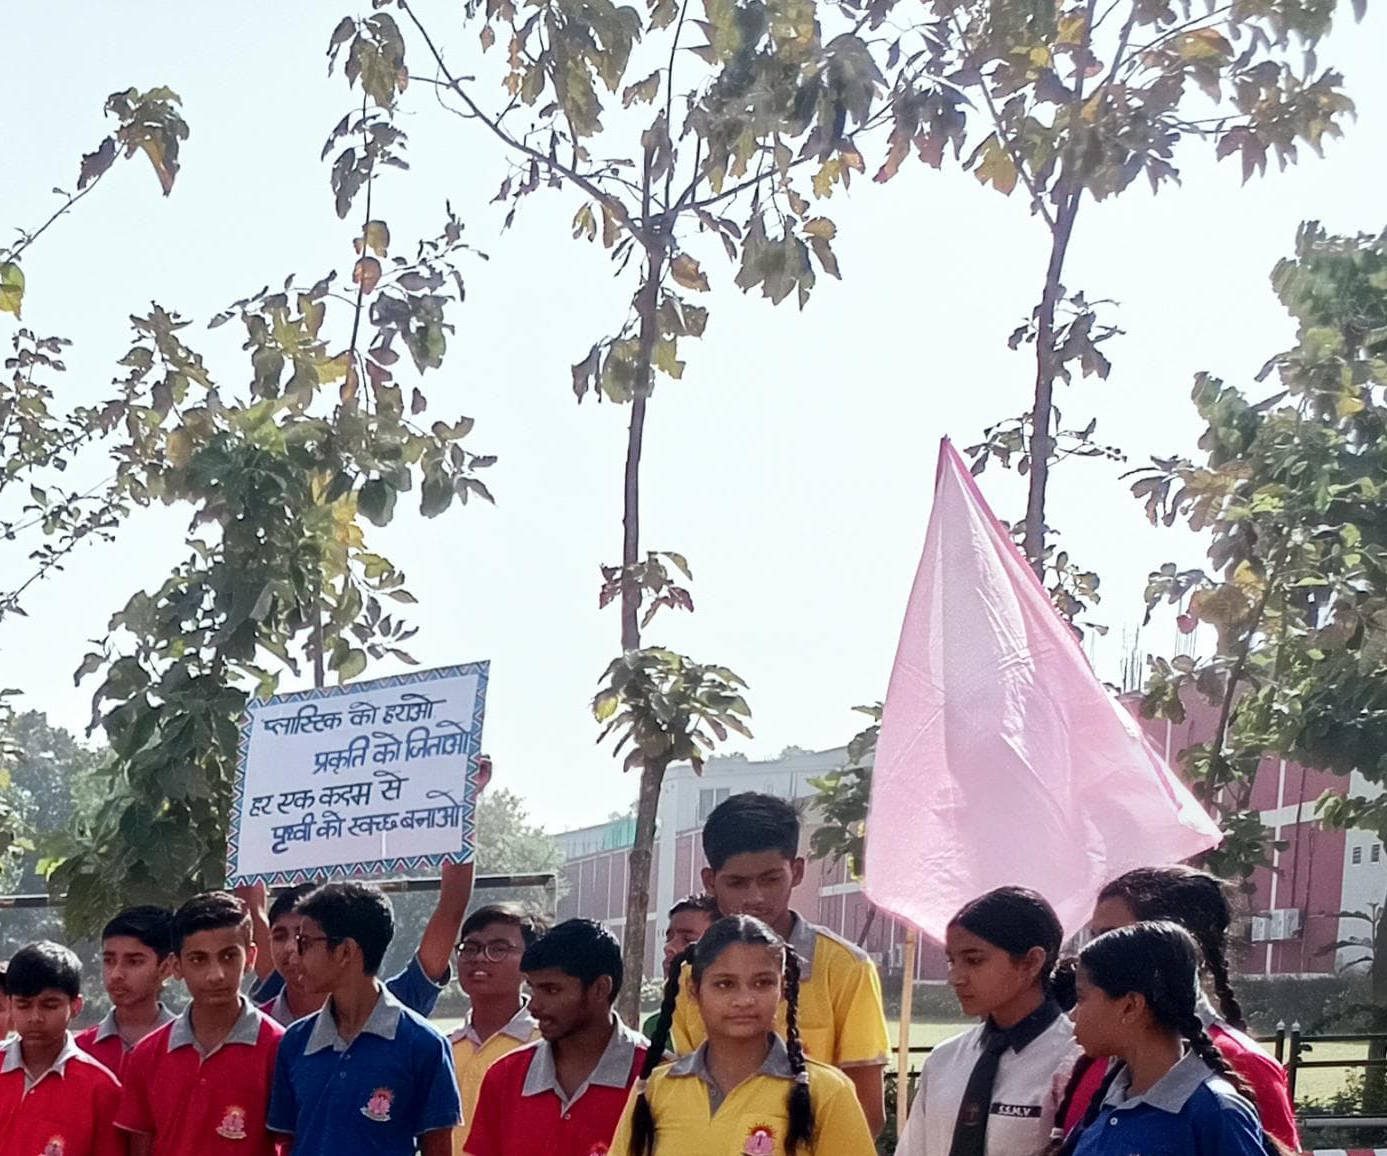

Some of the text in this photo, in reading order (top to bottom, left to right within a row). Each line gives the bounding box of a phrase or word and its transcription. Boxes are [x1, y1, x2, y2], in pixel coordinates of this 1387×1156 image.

[263, 693, 447, 736] प्लास्टिक को हराओ
[312, 720, 472, 775] प्रकृति को जिताओ
[249, 770, 409, 817] हर एक कदम से
[271, 812, 315, 854] पृथ्वी
[316, 810, 346, 840] को
[400, 790, 465, 829] बनाओ
